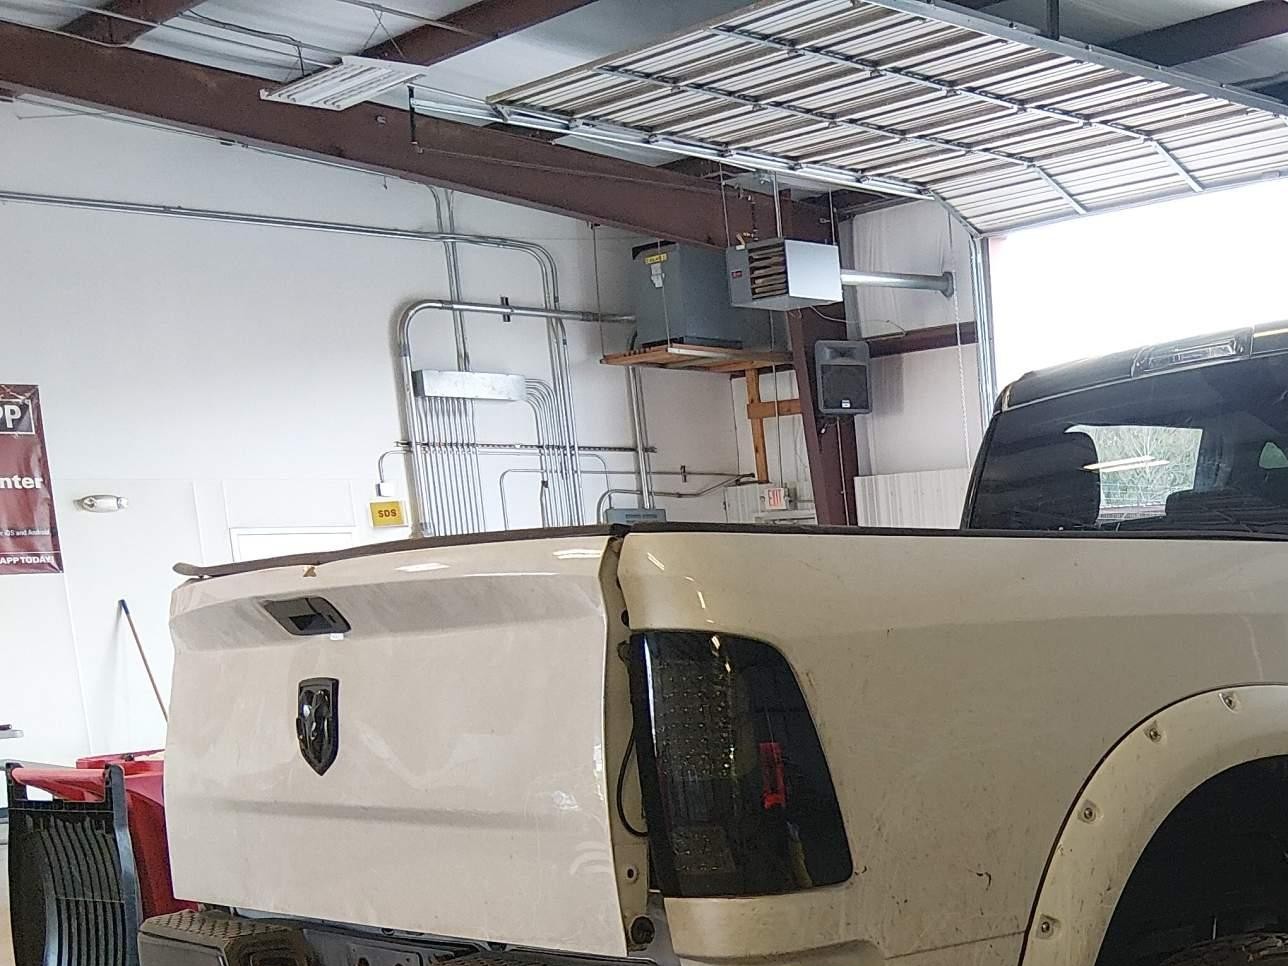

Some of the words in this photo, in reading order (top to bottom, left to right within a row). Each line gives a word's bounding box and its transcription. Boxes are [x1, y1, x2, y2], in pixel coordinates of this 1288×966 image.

[377, 508, 398, 519] SDS
[16, 529, 27, 537] and
[0, 556, 19, 565] APP
